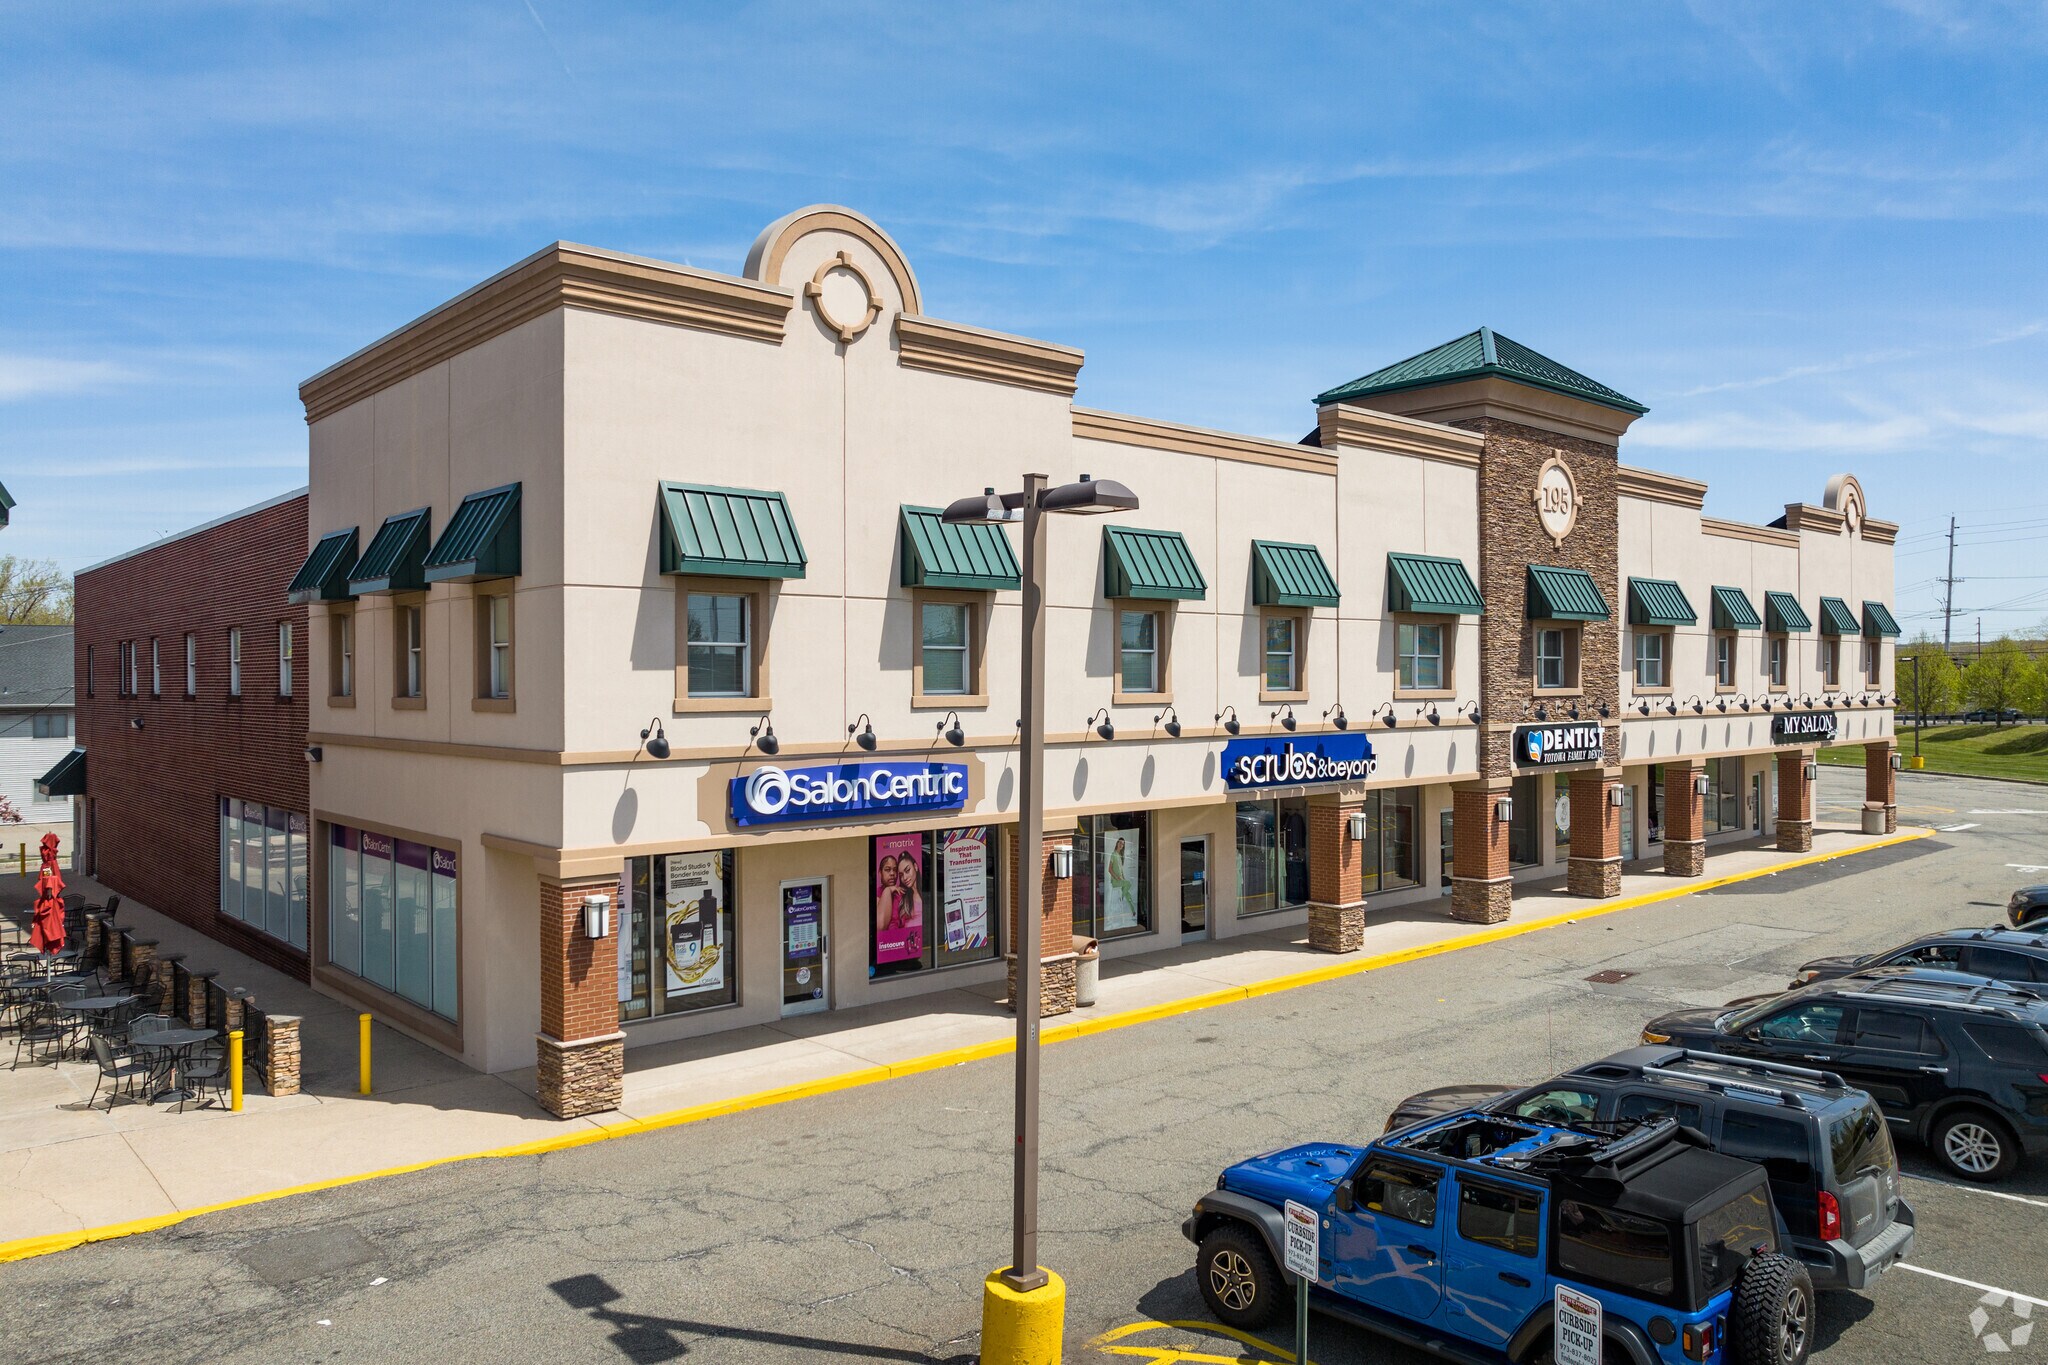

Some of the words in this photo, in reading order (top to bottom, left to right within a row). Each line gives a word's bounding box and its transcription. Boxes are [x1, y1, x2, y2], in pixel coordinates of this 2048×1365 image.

[1543, 485, 1569, 515] 195
[1784, 716, 1800, 735] MY
[1801, 714, 1833, 734] SALON
[1543, 727, 1606, 751] DENTIST
[1544, 752, 1566, 763] TOTOWA
[1567, 750, 1587, 761] FAMILY
[788, 765, 964, 806] SalonCentric
[889, 838, 915, 849] matrix
[950, 844, 981, 853] Inspiration
[670, 864, 688, 872] Blond
[949, 858, 982, 866] Transforms
[670, 871, 691, 879] Bonder
[689, 942, 697, 957] 9
[1288, 1220, 1316, 1244] CURBSIDE
[1290, 1235, 1313, 1256] PICK-UP
[1561, 1295, 1597, 1315] FIREHOUSE
[1559, 1309, 1598, 1338] CURBSIDE
[1562, 1327, 1594, 1352] PICK-UP
[1559, 1343, 1597, 1365] 973-837-8022
